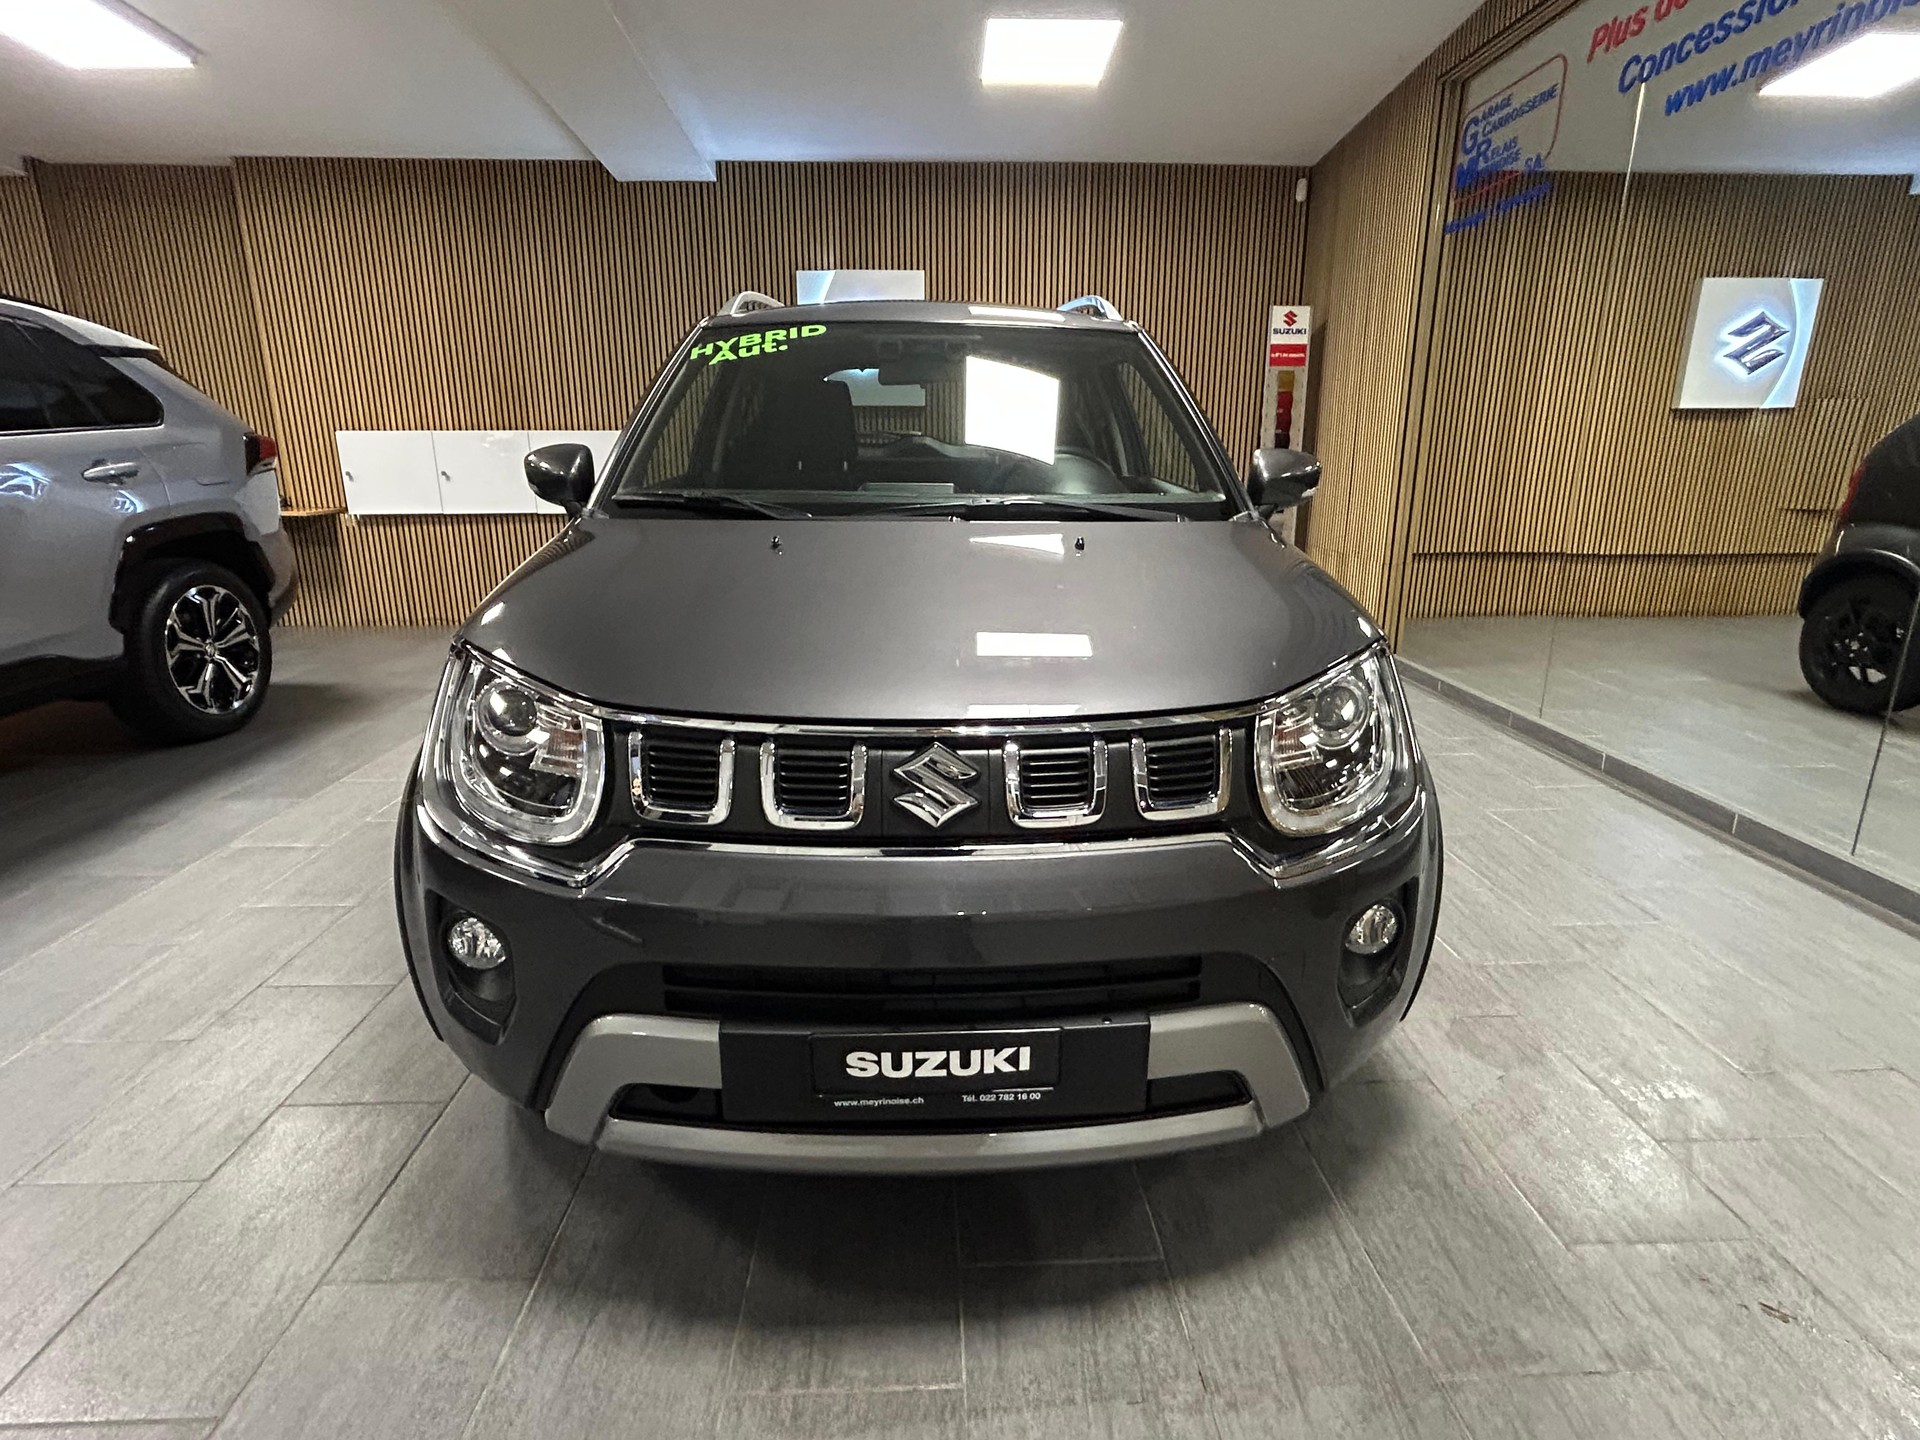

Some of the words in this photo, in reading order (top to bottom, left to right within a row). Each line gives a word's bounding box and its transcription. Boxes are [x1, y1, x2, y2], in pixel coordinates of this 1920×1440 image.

[1587, 5, 1649, 64] Plus
[1618, 0, 1798, 94] Concessio
[1664, 0, 1920, 117] www.meyrino
[1481, 82, 1559, 138] CARROSSERIE
[1477, 136, 1518, 164] RELAIS
[690, 325, 827, 360] HYBRID
[1272, 327, 1307, 335] SUZUKI
[708, 341, 788, 366] Aut.
[845, 1046, 1031, 1078] SUZUKI
[834, 1097, 924, 1107] www.meyrinoise.ch
